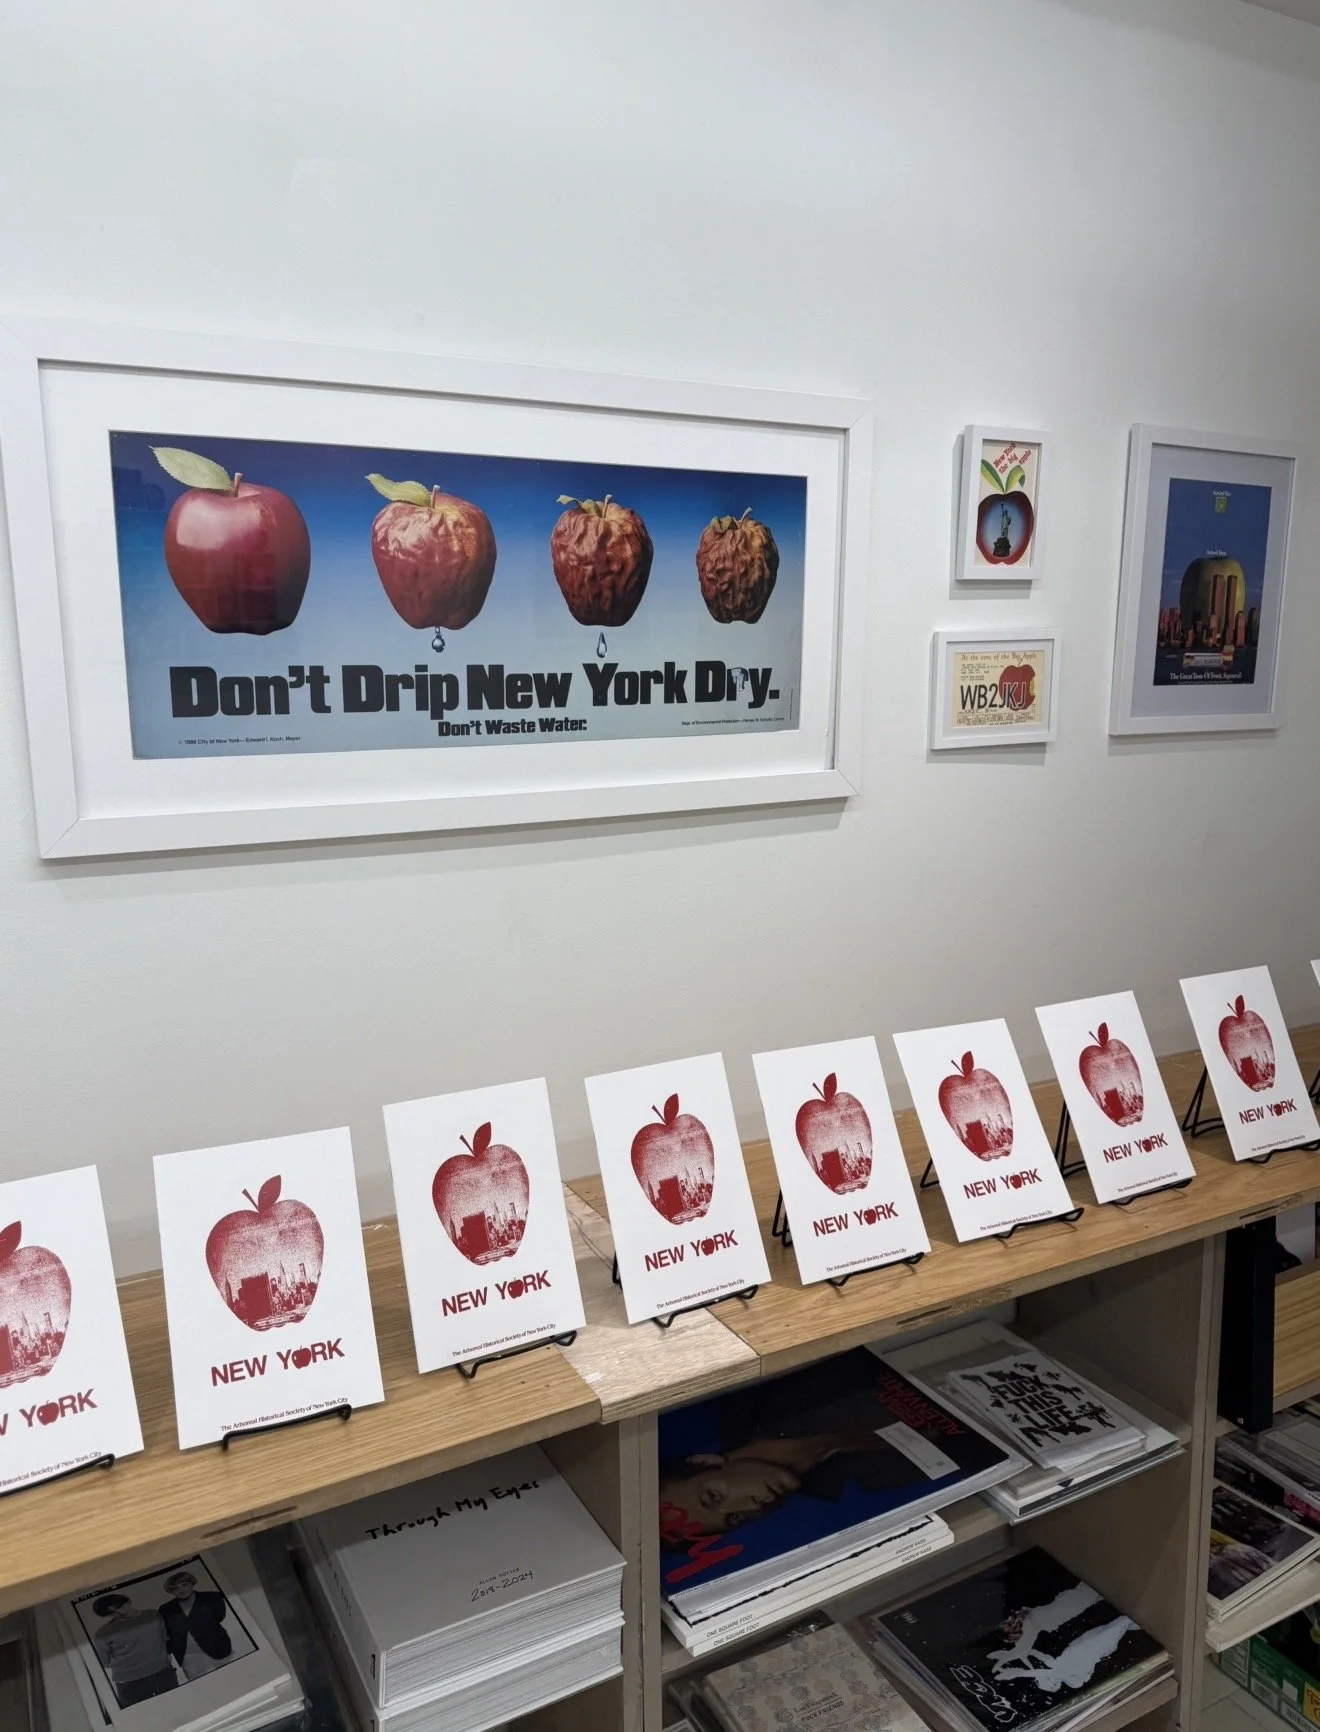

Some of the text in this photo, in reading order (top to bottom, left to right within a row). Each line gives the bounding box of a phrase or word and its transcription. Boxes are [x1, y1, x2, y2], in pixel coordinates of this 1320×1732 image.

[170, 664, 332, 718] Don't
[342, 664, 460, 720] Drip
[466, 664, 572, 710] New
[582, 662, 689, 707] York
[695, 660, 780, 709] Dry.
[961, 682, 1027, 710] WB2JKJ
[438, 717, 587, 738] Don't Waste Water.
[1239, 1107, 1264, 1124] NEW
[1103, 1143, 1132, 1163] NEW
[963, 1178, 996, 1199] NEW
[813, 1213, 848, 1237] NEW
[645, 1245, 684, 1272] NEW
[442, 1287, 488, 1317] NEW
[701, 1288, 716, 1296] Society
[505, 1332, 522, 1341] Society
[536, 1325, 547, 1333] York
[211, 1355, 267, 1387] NEW
[993, 1375, 1050, 1400] FUCK
[258, 1411, 285, 1423] Historical
[285, 1407, 306, 1417] Society
[312, 1402, 325, 1410] New
[324, 1400, 338, 1408] York
[1007, 1391, 1063, 1414] THIS
[1023, 1404, 1081, 1429] LIFE
[30, 1467, 54, 1477] Society
[61, 1459, 75, 1468] New
[75, 1455, 89, 1464] York
[90, 1451, 102, 1460] City
[365, 1480, 541, 1541] Through My Eyes
[706, 1614, 753, 1638] ONE SQUARE FOOT
[713, 1622, 760, 1646] ONE SQUARE FOOT
